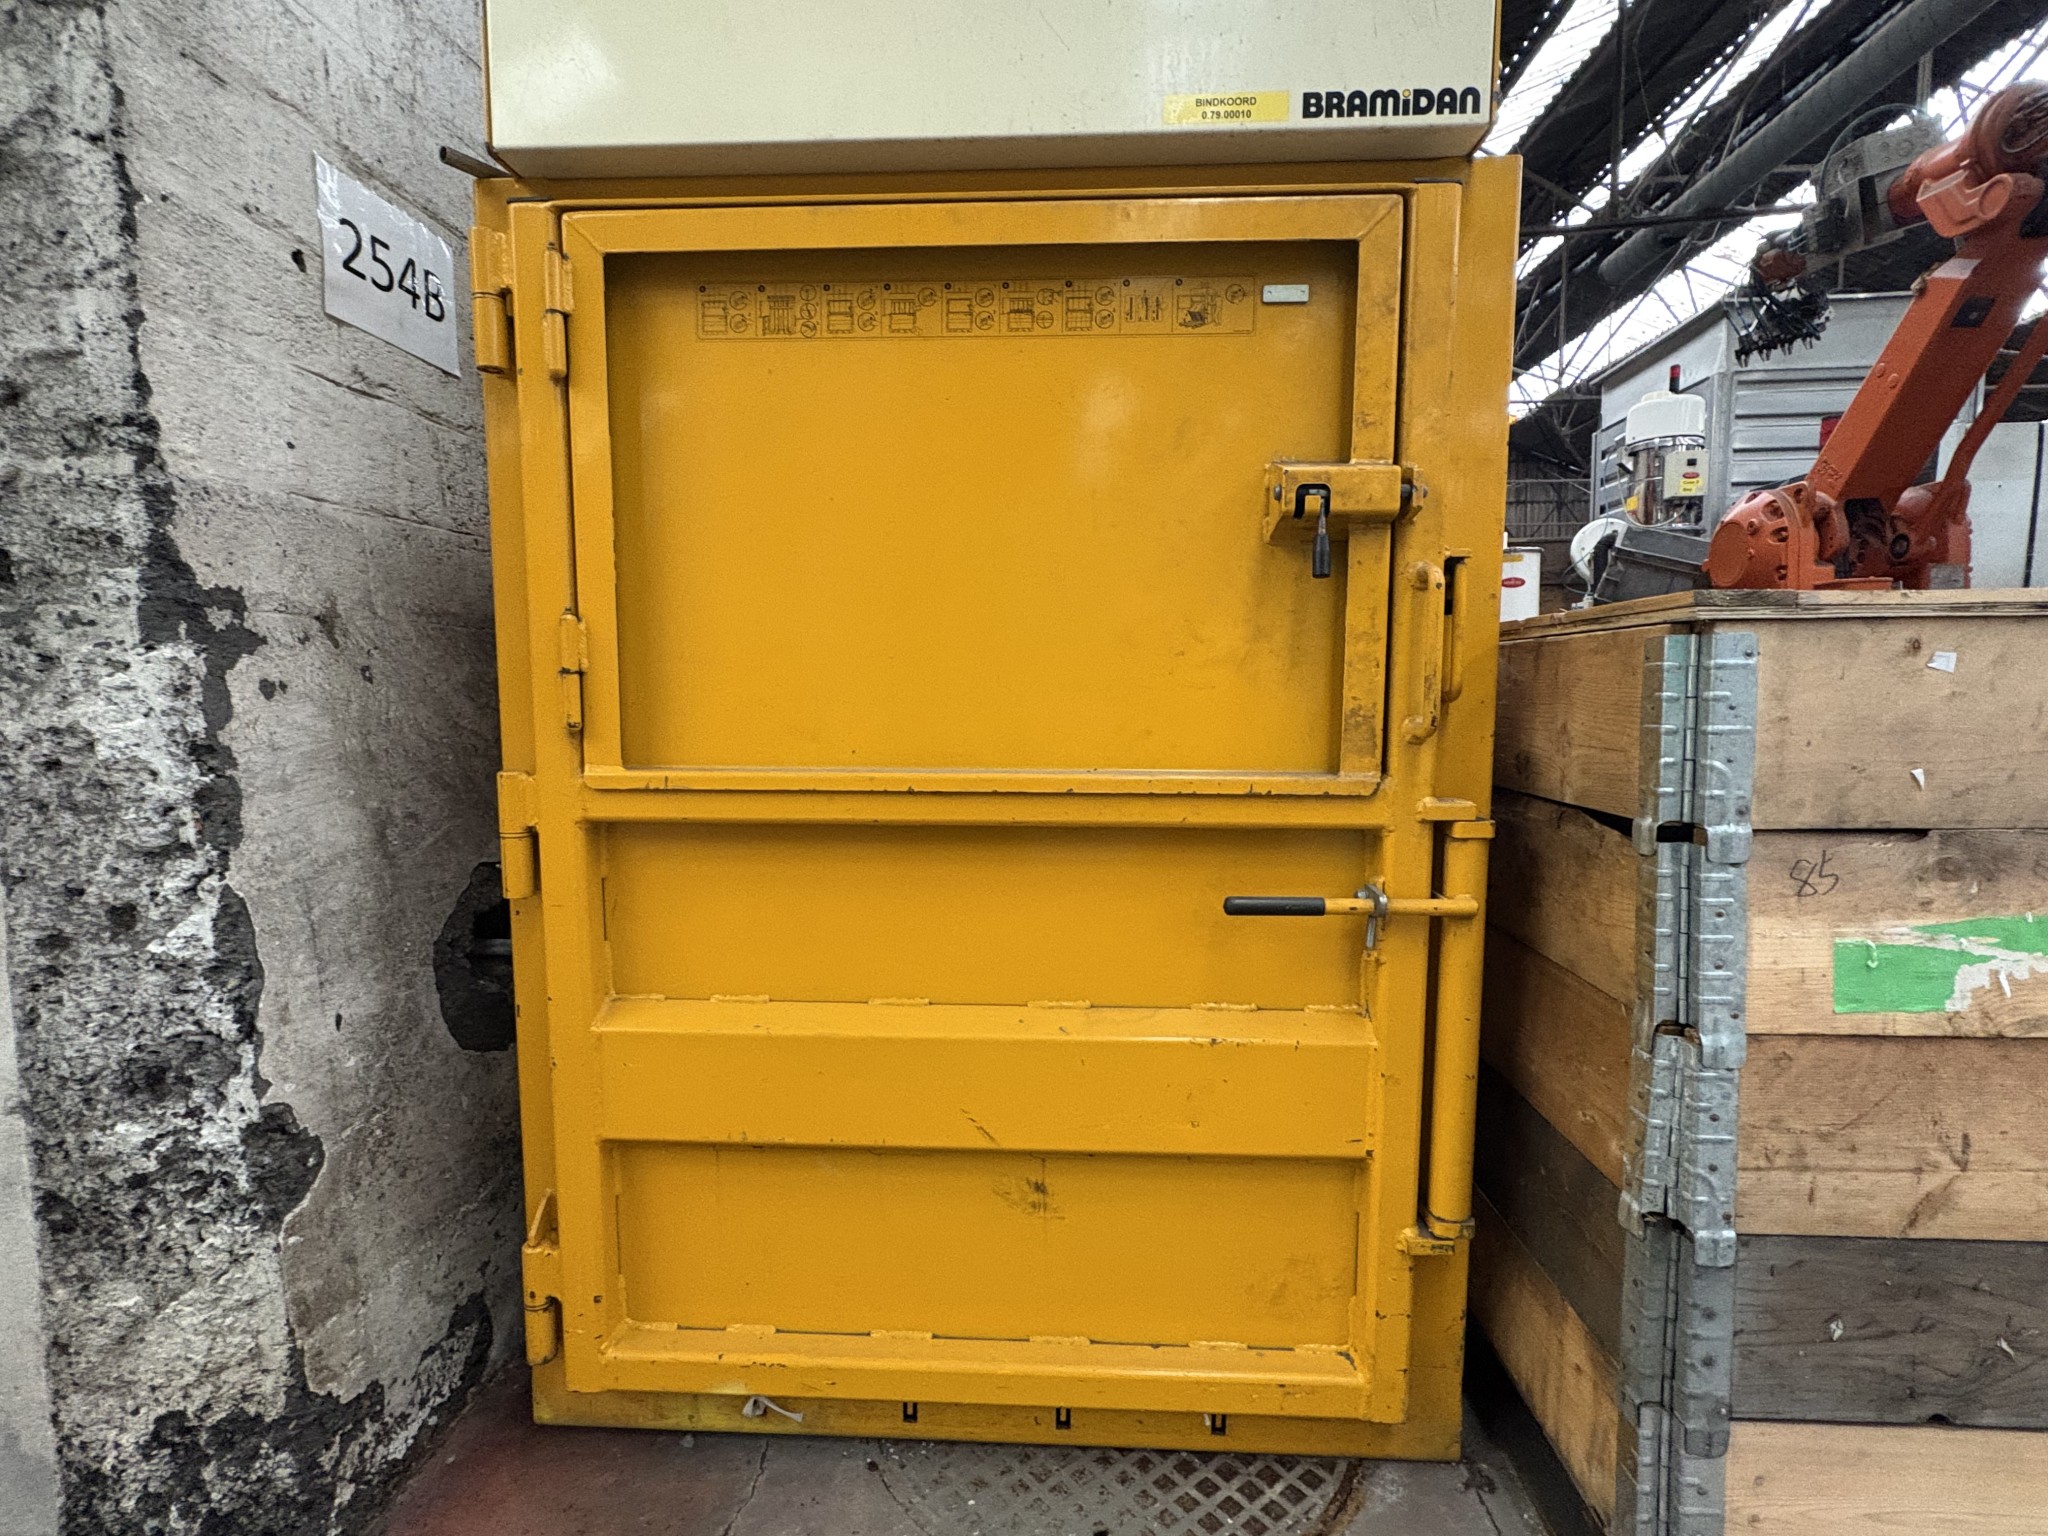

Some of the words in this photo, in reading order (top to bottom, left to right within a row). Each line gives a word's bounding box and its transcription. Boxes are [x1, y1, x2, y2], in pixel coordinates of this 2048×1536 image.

[1195, 96, 1257, 107] BINDKOORD
[1201, 109, 1252, 120] 0.79.00010
[339, 217, 445, 322] 254B
[1790, 849, 1840, 897] 85
